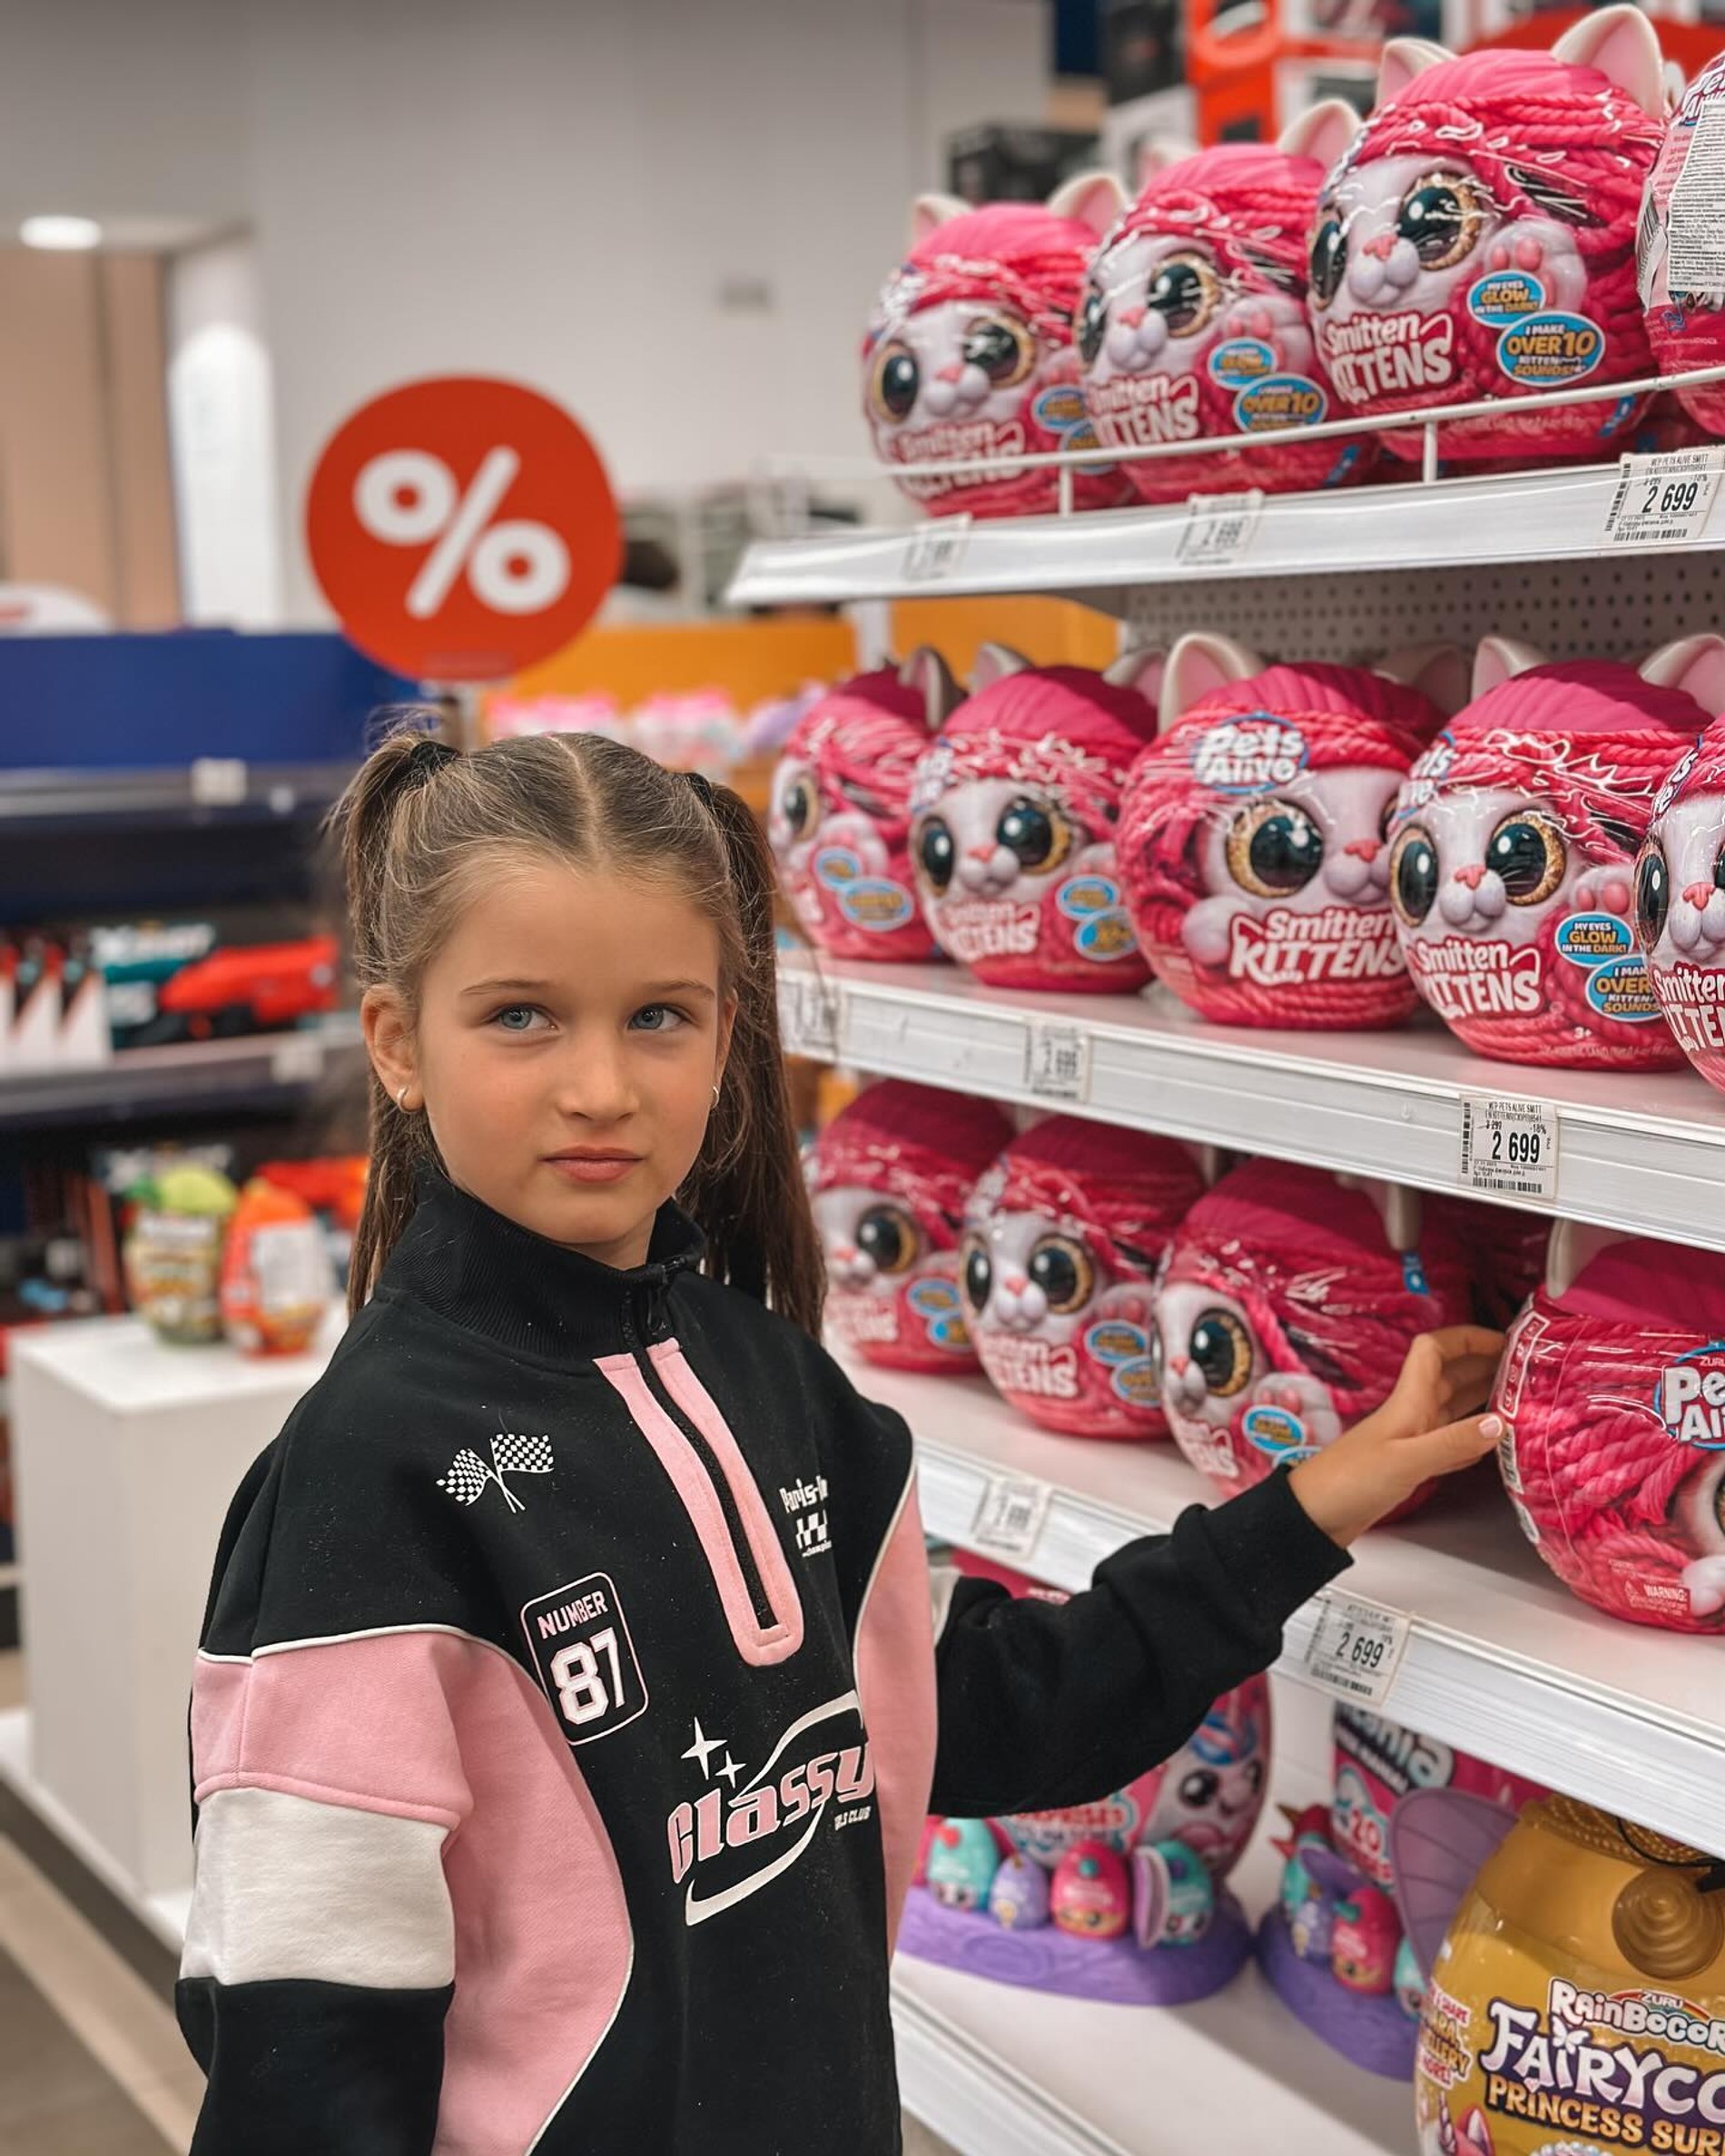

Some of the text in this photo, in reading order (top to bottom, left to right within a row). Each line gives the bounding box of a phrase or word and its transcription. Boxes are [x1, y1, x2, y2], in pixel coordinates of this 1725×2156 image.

[1481, 289, 1529, 303] GLOW
[1326, 314, 1420, 356] Smitten
[1533, 324, 1565, 335] MAKE
[1507, 330, 1596, 356] OVER 10
[1289, 391, 1320, 413] 10
[1641, 482, 1699, 513] 2 699
[1264, 908, 1396, 941] Smitten
[1569, 931, 1617, 944] GLOW
[1573, 921, 1612, 930] MY EYES
[1228, 930, 1407, 987] KITTENS
[1416, 939, 1509, 972] Smitten
[1562, 943, 1627, 953] IN THE DARK!
[1614, 967, 1649, 978] I MAK
[1596, 978, 1651, 994] OVER
[1608, 994, 1649, 1003] KITTEN
[1574, 1026, 1592, 1039] 3+
[1492, 1130, 1541, 1164] 2 699
[1665, 1365, 1725, 1425] Pe
[537, 1590, 609, 1639] NUMBER
[1336, 1631, 1385, 1669] 2 699
[550, 1626, 626, 1725] 87
[667, 1743, 875, 1885] Classy
[1641, 1991, 1684, 2009] ZURU
